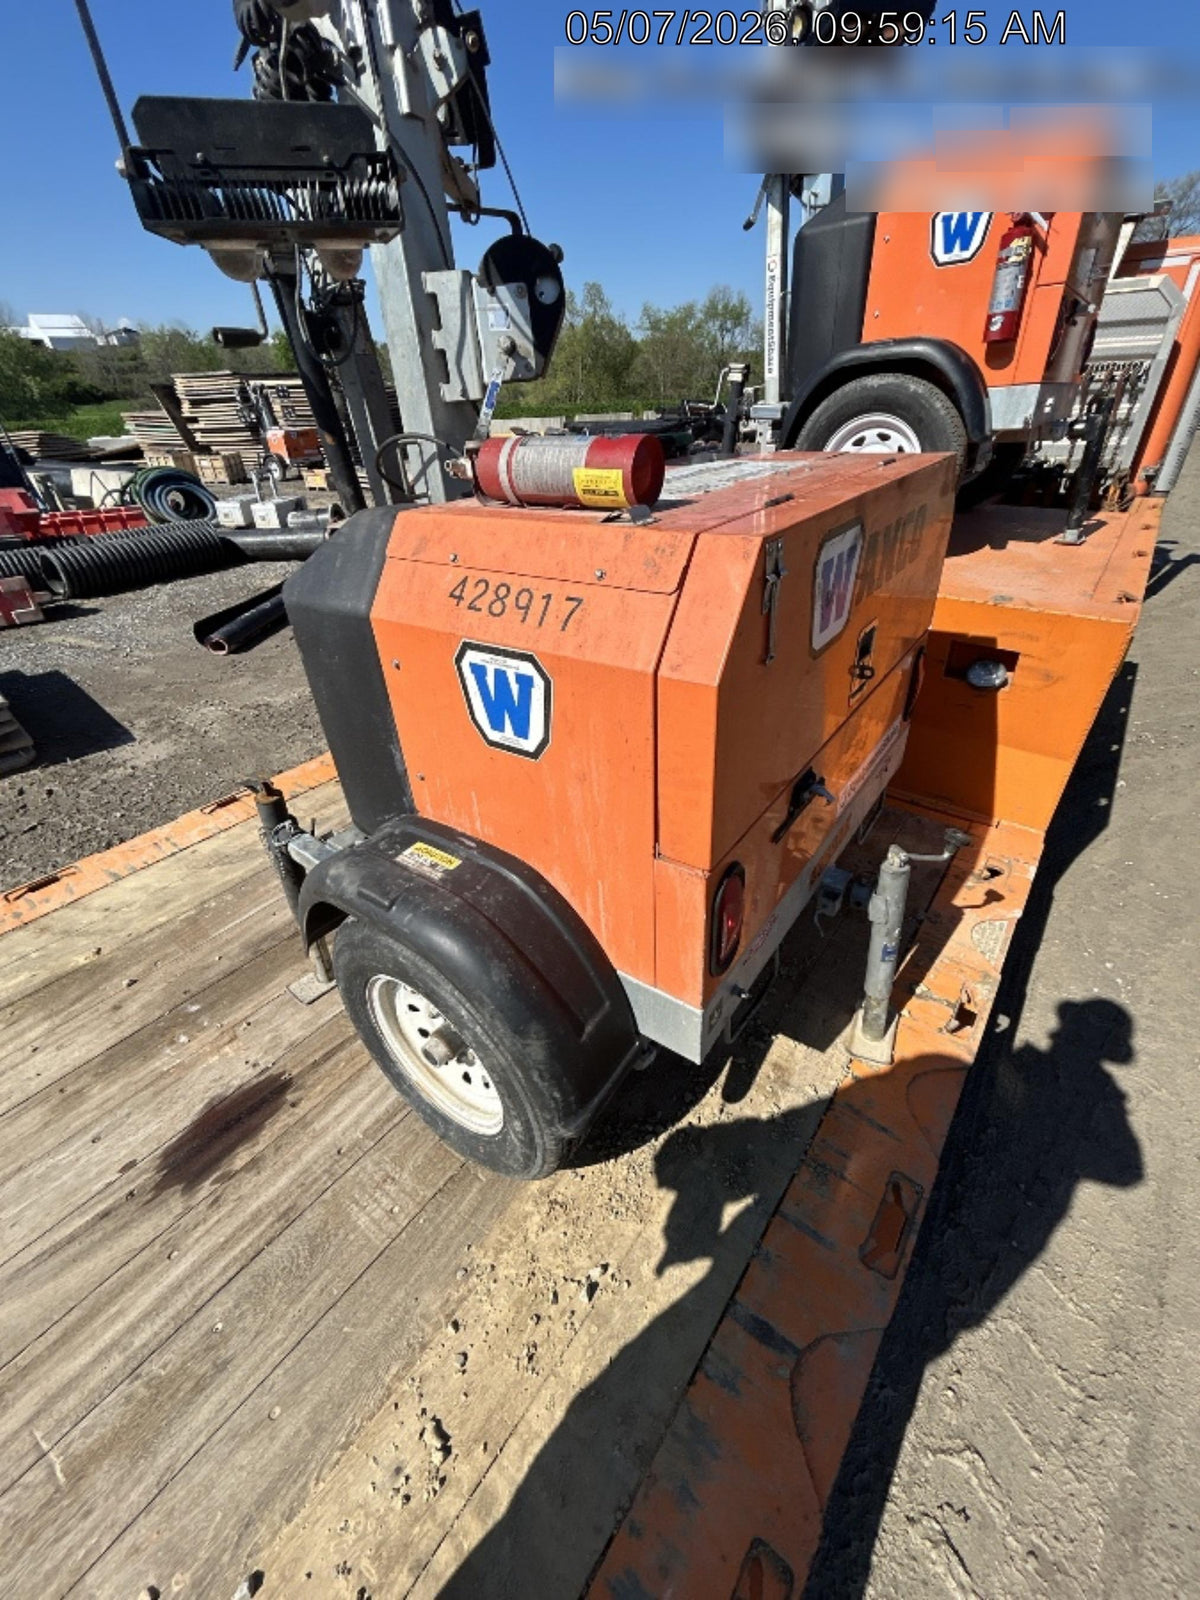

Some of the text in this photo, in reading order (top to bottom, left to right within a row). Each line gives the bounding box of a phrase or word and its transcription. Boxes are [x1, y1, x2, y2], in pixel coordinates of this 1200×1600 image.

[941, 212, 984, 255] W
[448, 575, 584, 632] 428917
[468, 661, 535, 741] W
